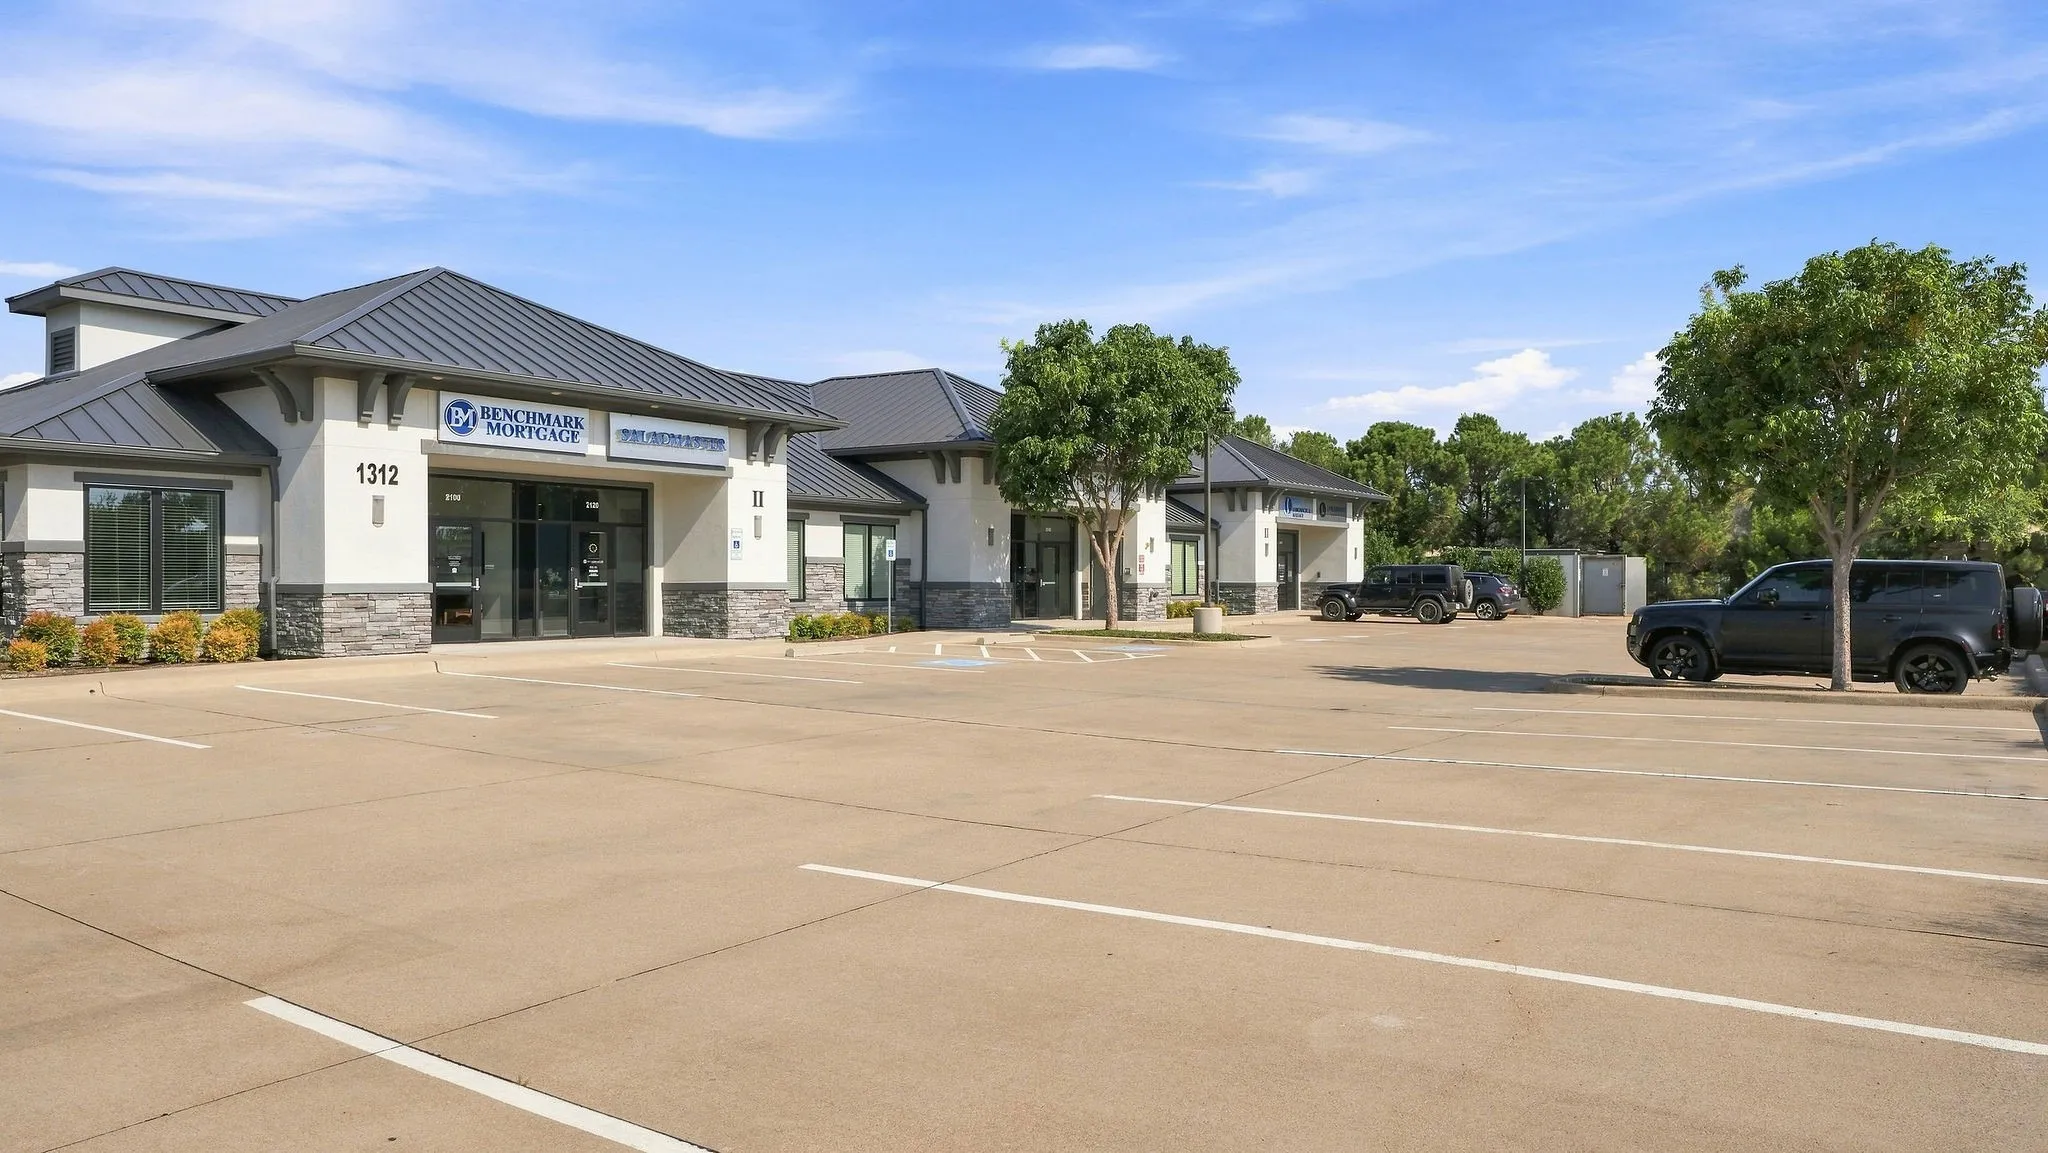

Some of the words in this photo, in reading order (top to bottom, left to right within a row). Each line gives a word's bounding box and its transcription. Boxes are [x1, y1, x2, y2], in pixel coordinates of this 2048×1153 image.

[480, 405, 585, 430] BENCHMARK
[486, 421, 581, 443] MORTGAGE
[620, 428, 727, 452] SALADMASTER
[356, 462, 399, 486] 1312
[445, 493, 461, 502] 2100
[585, 501, 600, 509] 2120
